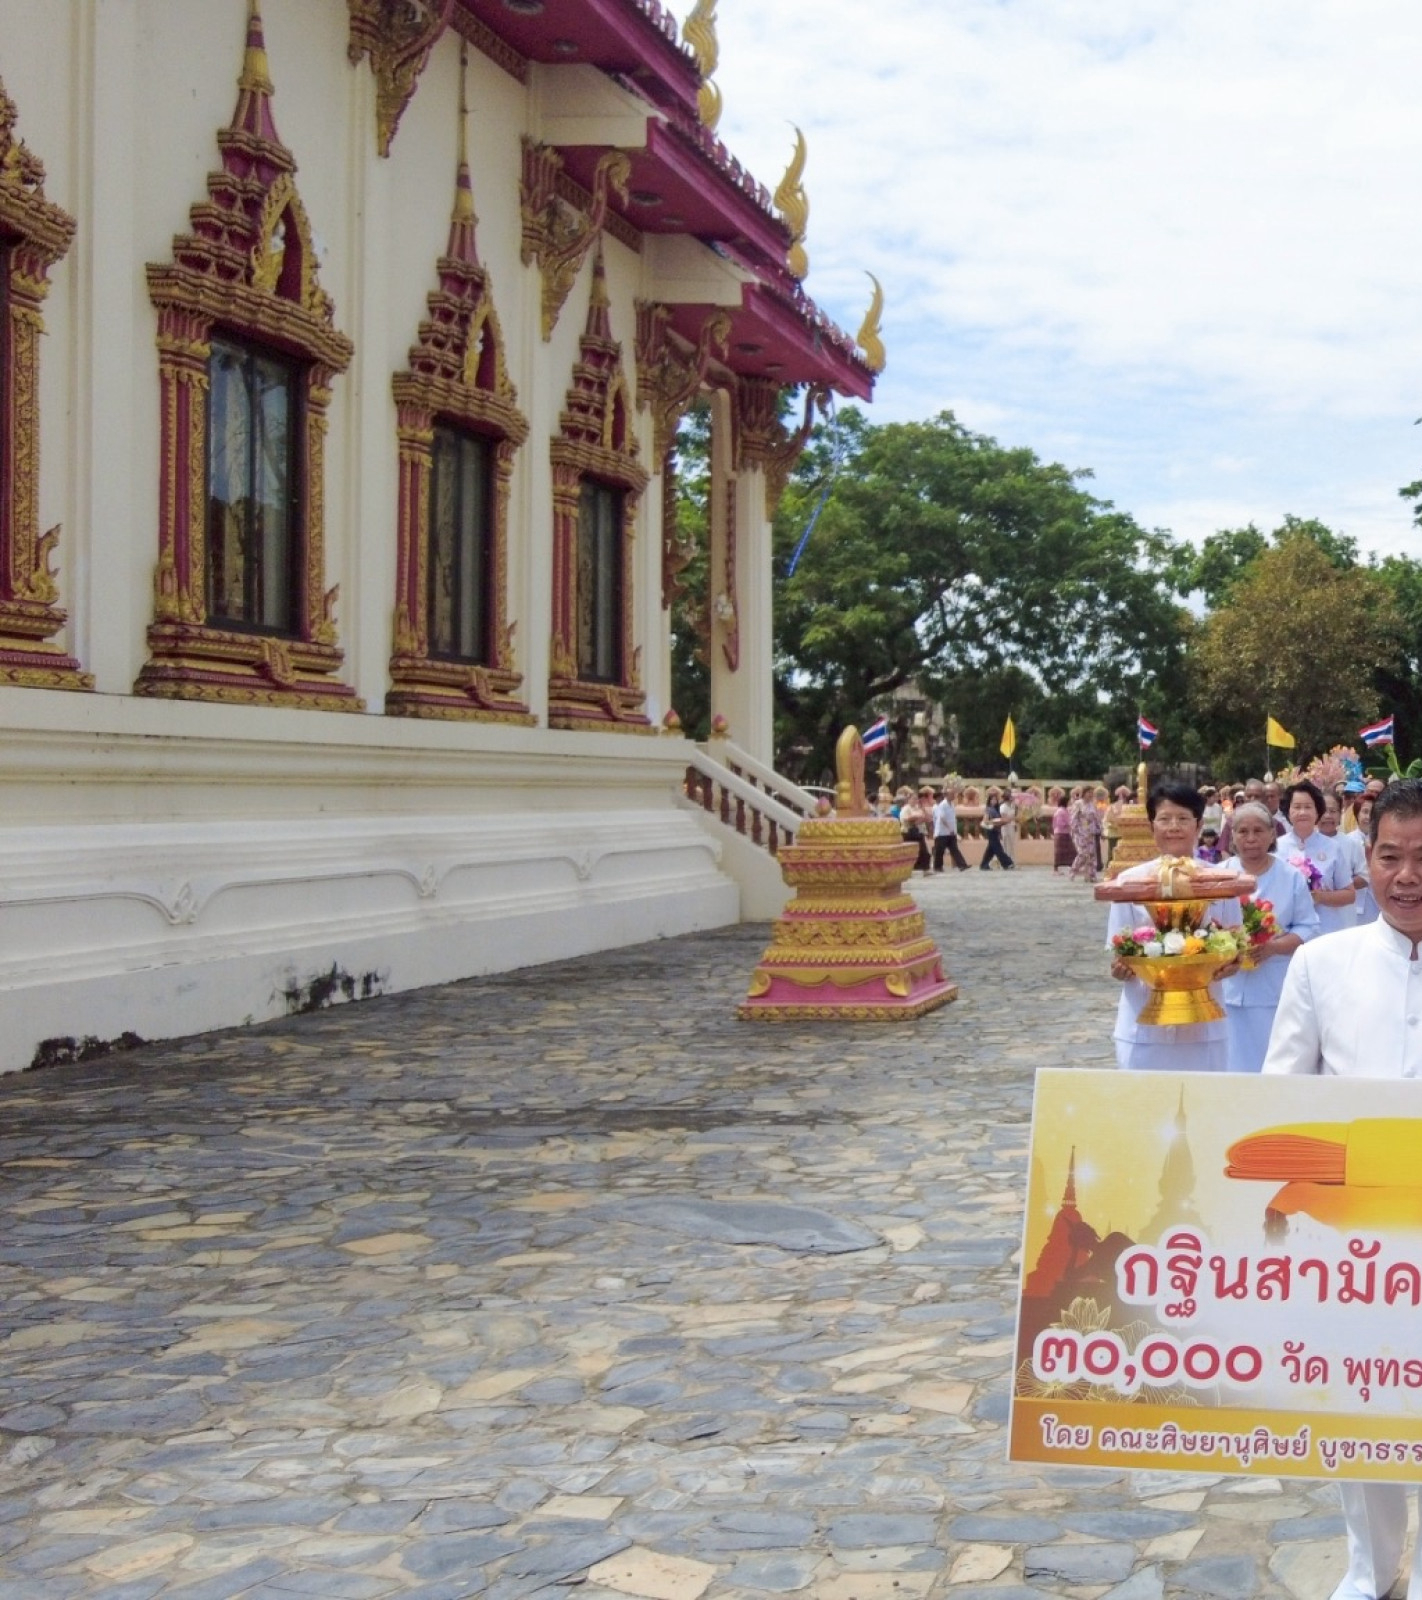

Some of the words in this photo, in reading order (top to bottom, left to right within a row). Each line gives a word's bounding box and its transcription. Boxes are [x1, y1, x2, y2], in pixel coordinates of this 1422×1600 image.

[1040, 1336, 1263, 1386] ๓๐,๐๐๐
[1281, 1340, 1330, 1384] วัด
[1042, 1417, 1090, 1446] โดย
[1101, 1425, 1308, 1464] คณะศิษยานุศิษย์
